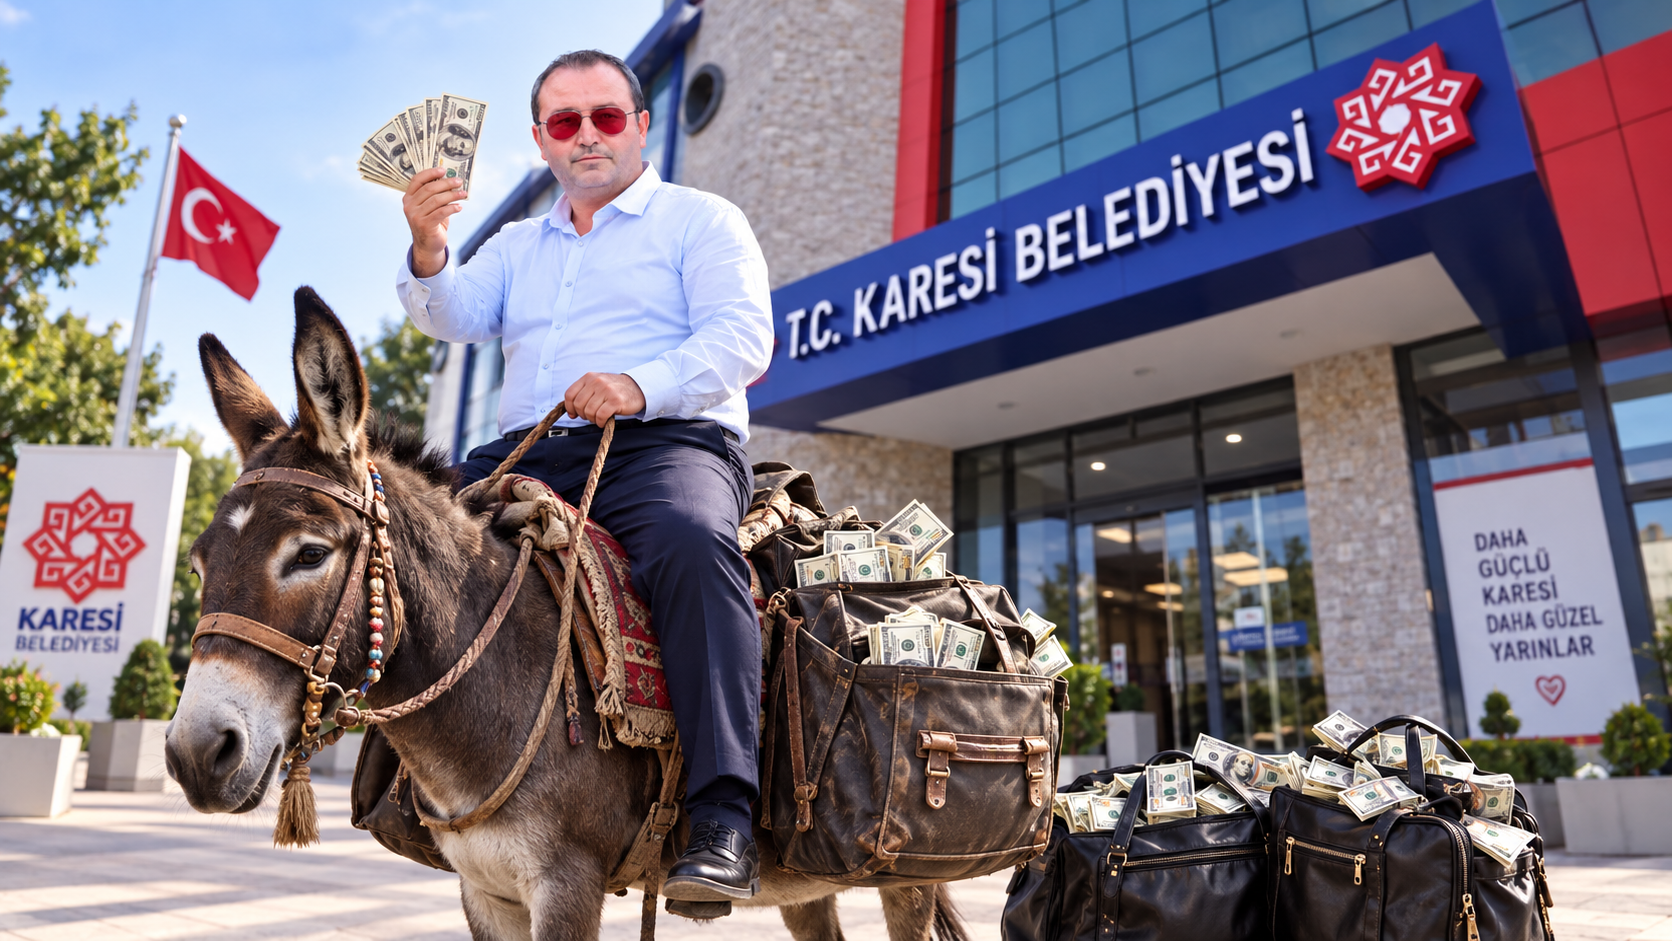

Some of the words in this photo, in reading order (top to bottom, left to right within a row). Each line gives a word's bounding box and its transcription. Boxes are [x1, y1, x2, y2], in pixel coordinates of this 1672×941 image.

[786, 300, 841, 359] T.C.
[853, 228, 996, 337] KARESİ
[1015, 108, 1314, 283] BELEDİYESİ
[1474, 527, 1528, 551] DAHA
[1478, 547, 1550, 579] GÜÇLÜ
[1482, 575, 1558, 605] KARESİ
[17, 602, 124, 632] KARESİ
[1486, 612, 1537, 634] DAHA
[1542, 604, 1603, 629] GÜZEL
[15, 634, 119, 653] BELEDİYESİ
[1490, 635, 1595, 662] YARINLAR
